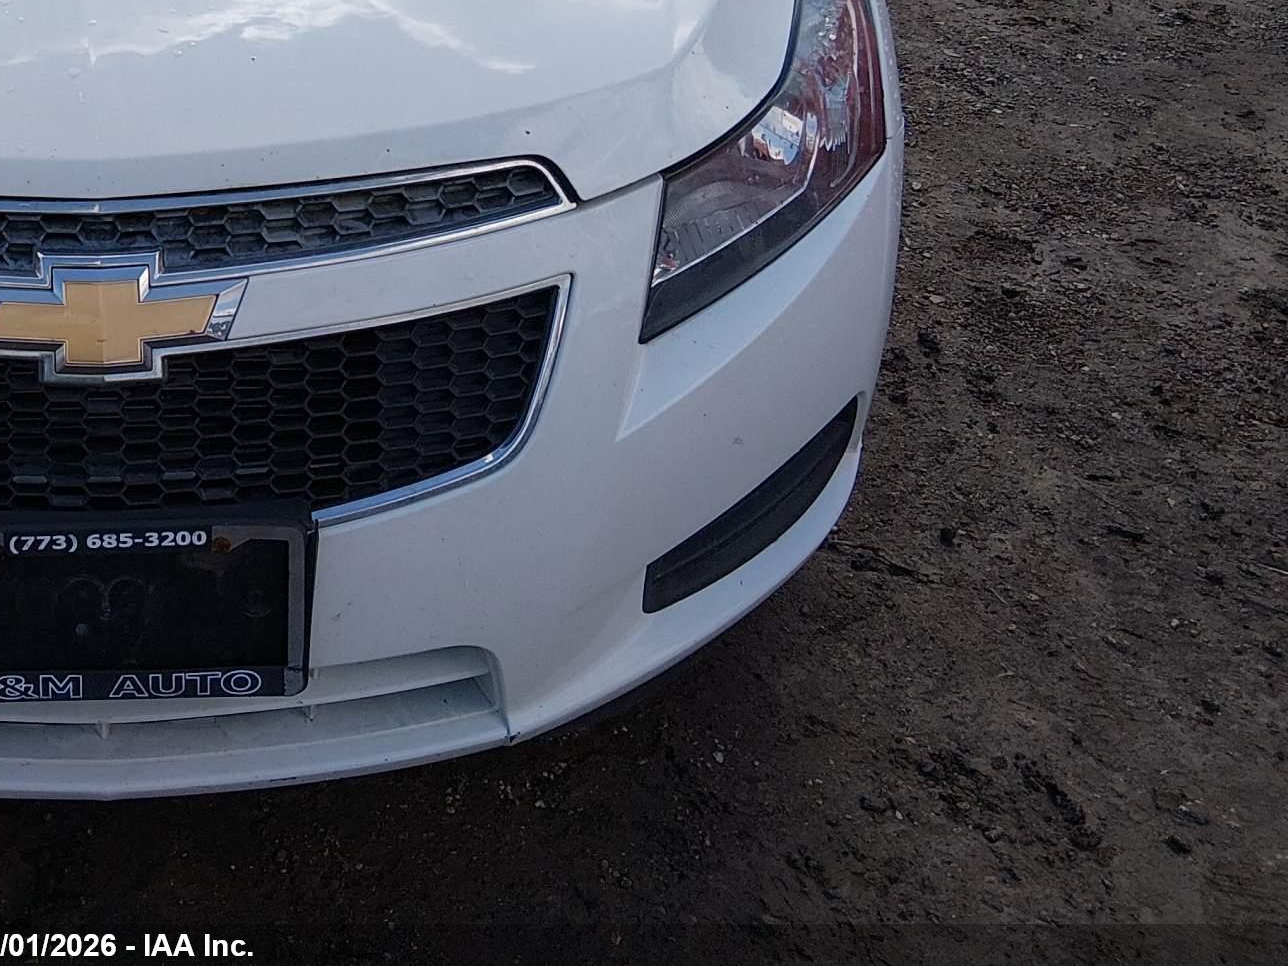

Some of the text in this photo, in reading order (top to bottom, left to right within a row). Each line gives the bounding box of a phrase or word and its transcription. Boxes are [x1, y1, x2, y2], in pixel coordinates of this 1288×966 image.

[8, 530, 207, 555] (773) 685-3200
[109, 669, 262, 698] AUTO
